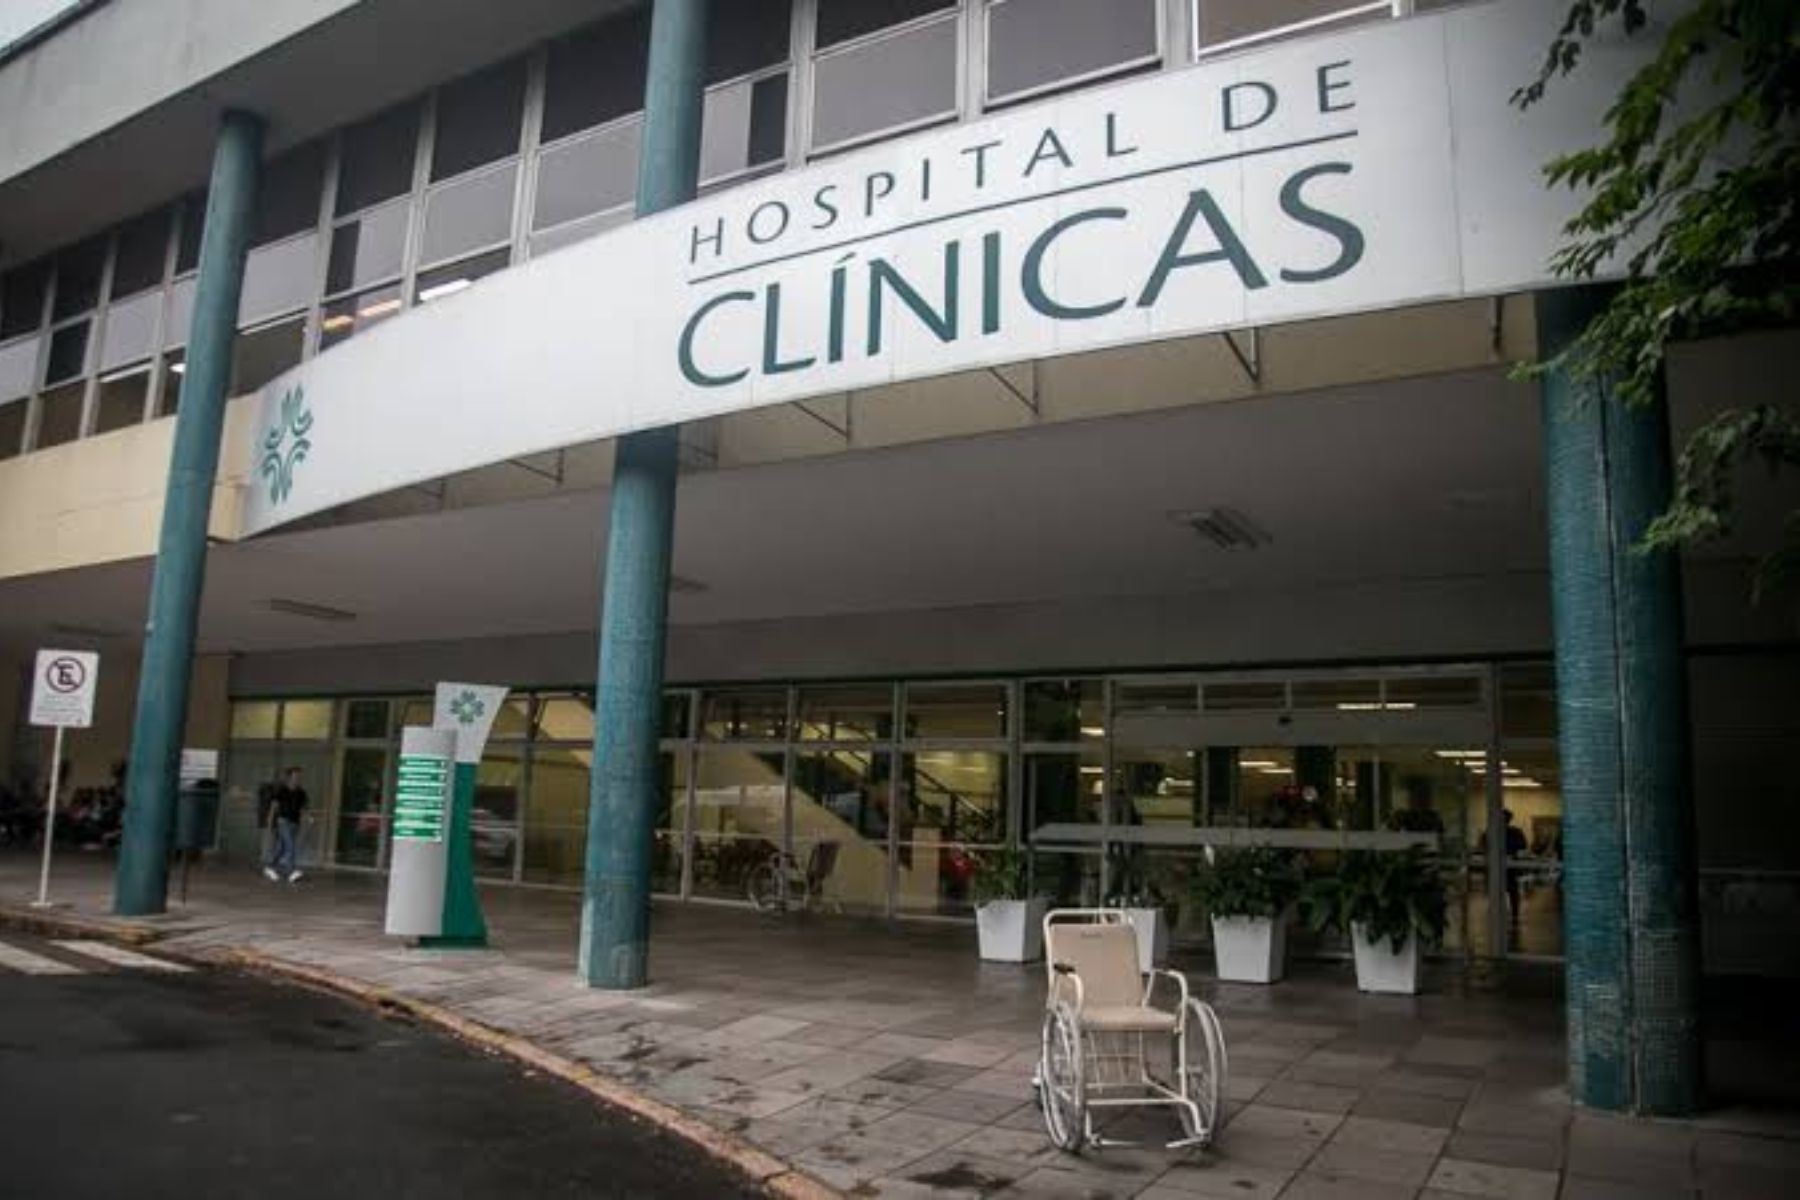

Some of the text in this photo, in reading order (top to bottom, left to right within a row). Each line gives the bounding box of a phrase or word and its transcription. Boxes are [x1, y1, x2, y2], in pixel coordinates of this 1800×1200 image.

[689, 60, 1357, 264] HOSPITAL DE
[677, 162, 1365, 388] CLÍNICAS
